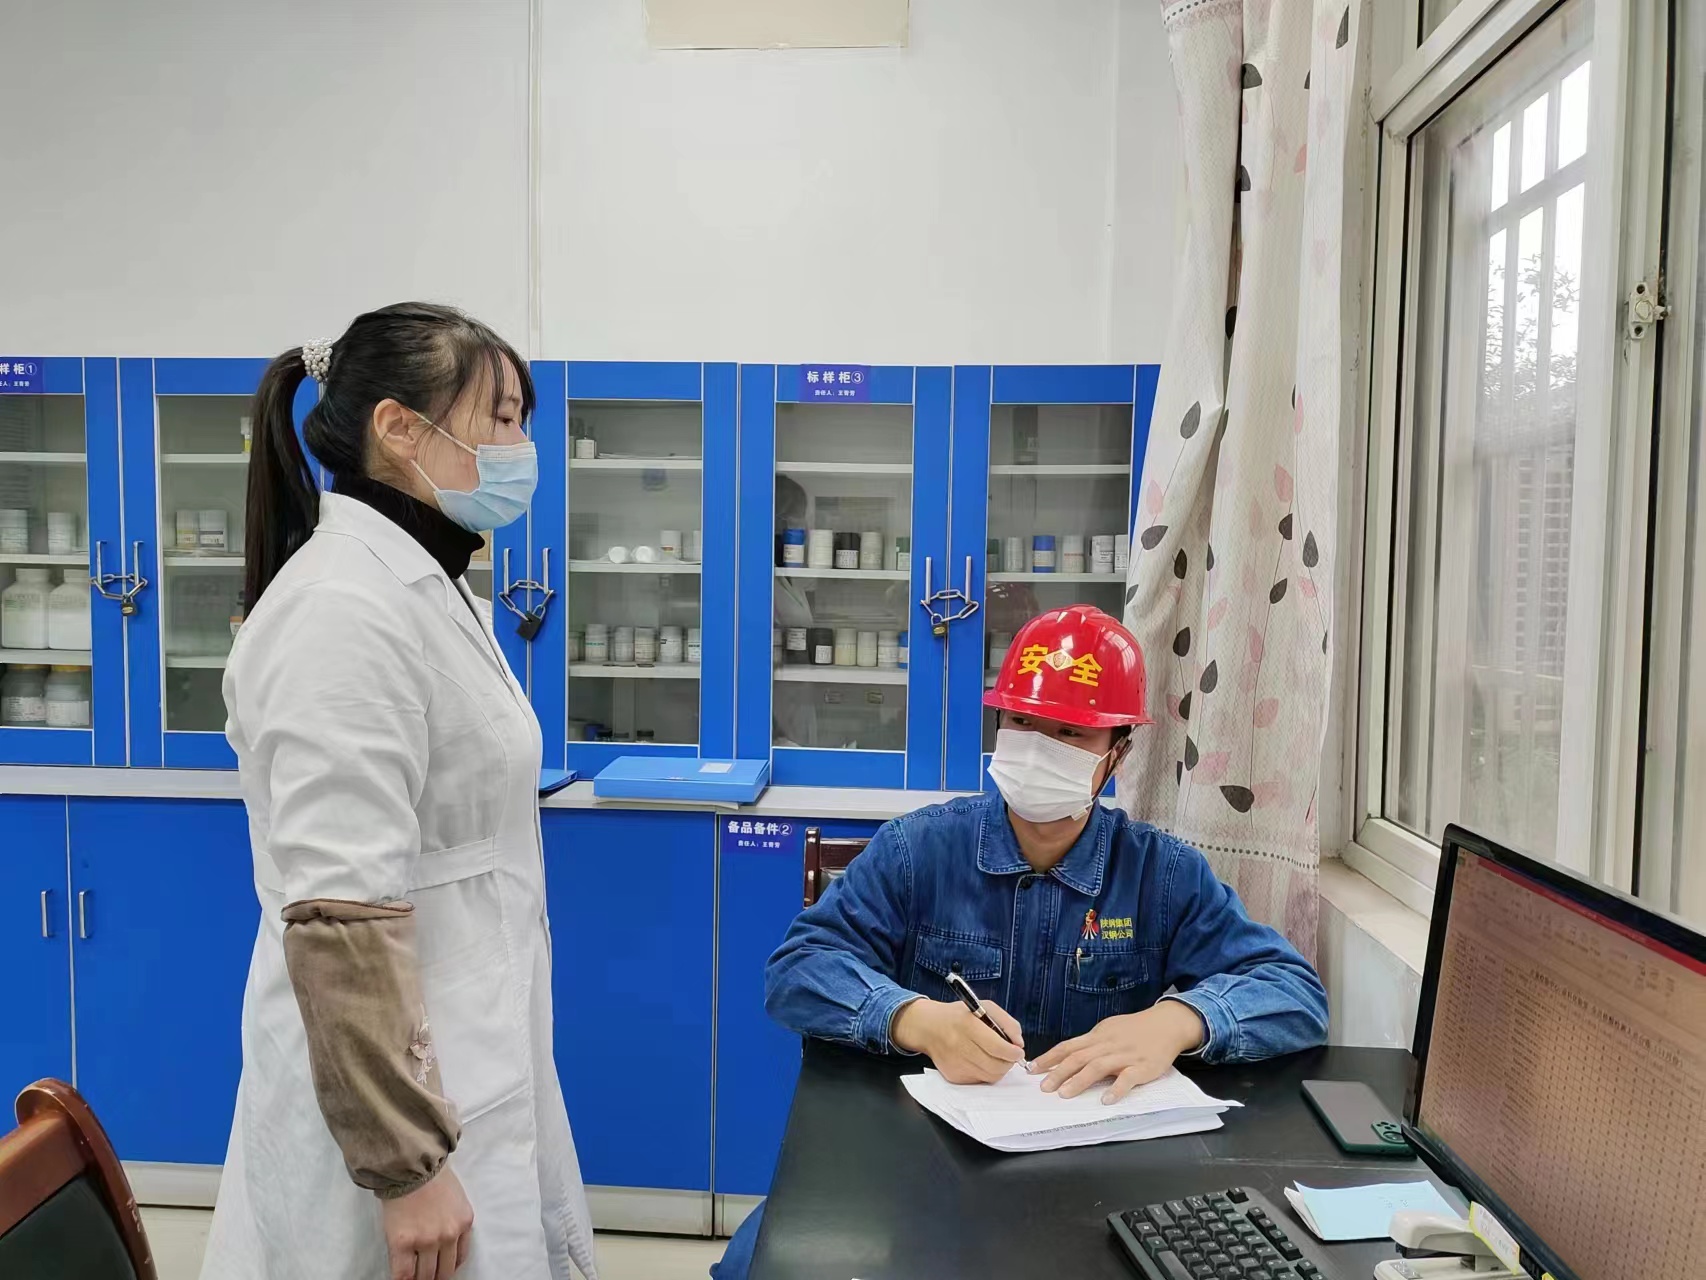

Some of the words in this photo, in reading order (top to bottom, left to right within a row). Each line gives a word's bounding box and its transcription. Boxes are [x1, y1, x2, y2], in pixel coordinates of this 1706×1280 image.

[807, 371, 864, 384] 标样柜③
[1017, 644, 1103, 687] 安全
[727, 820, 793, 837] 备品备件②
